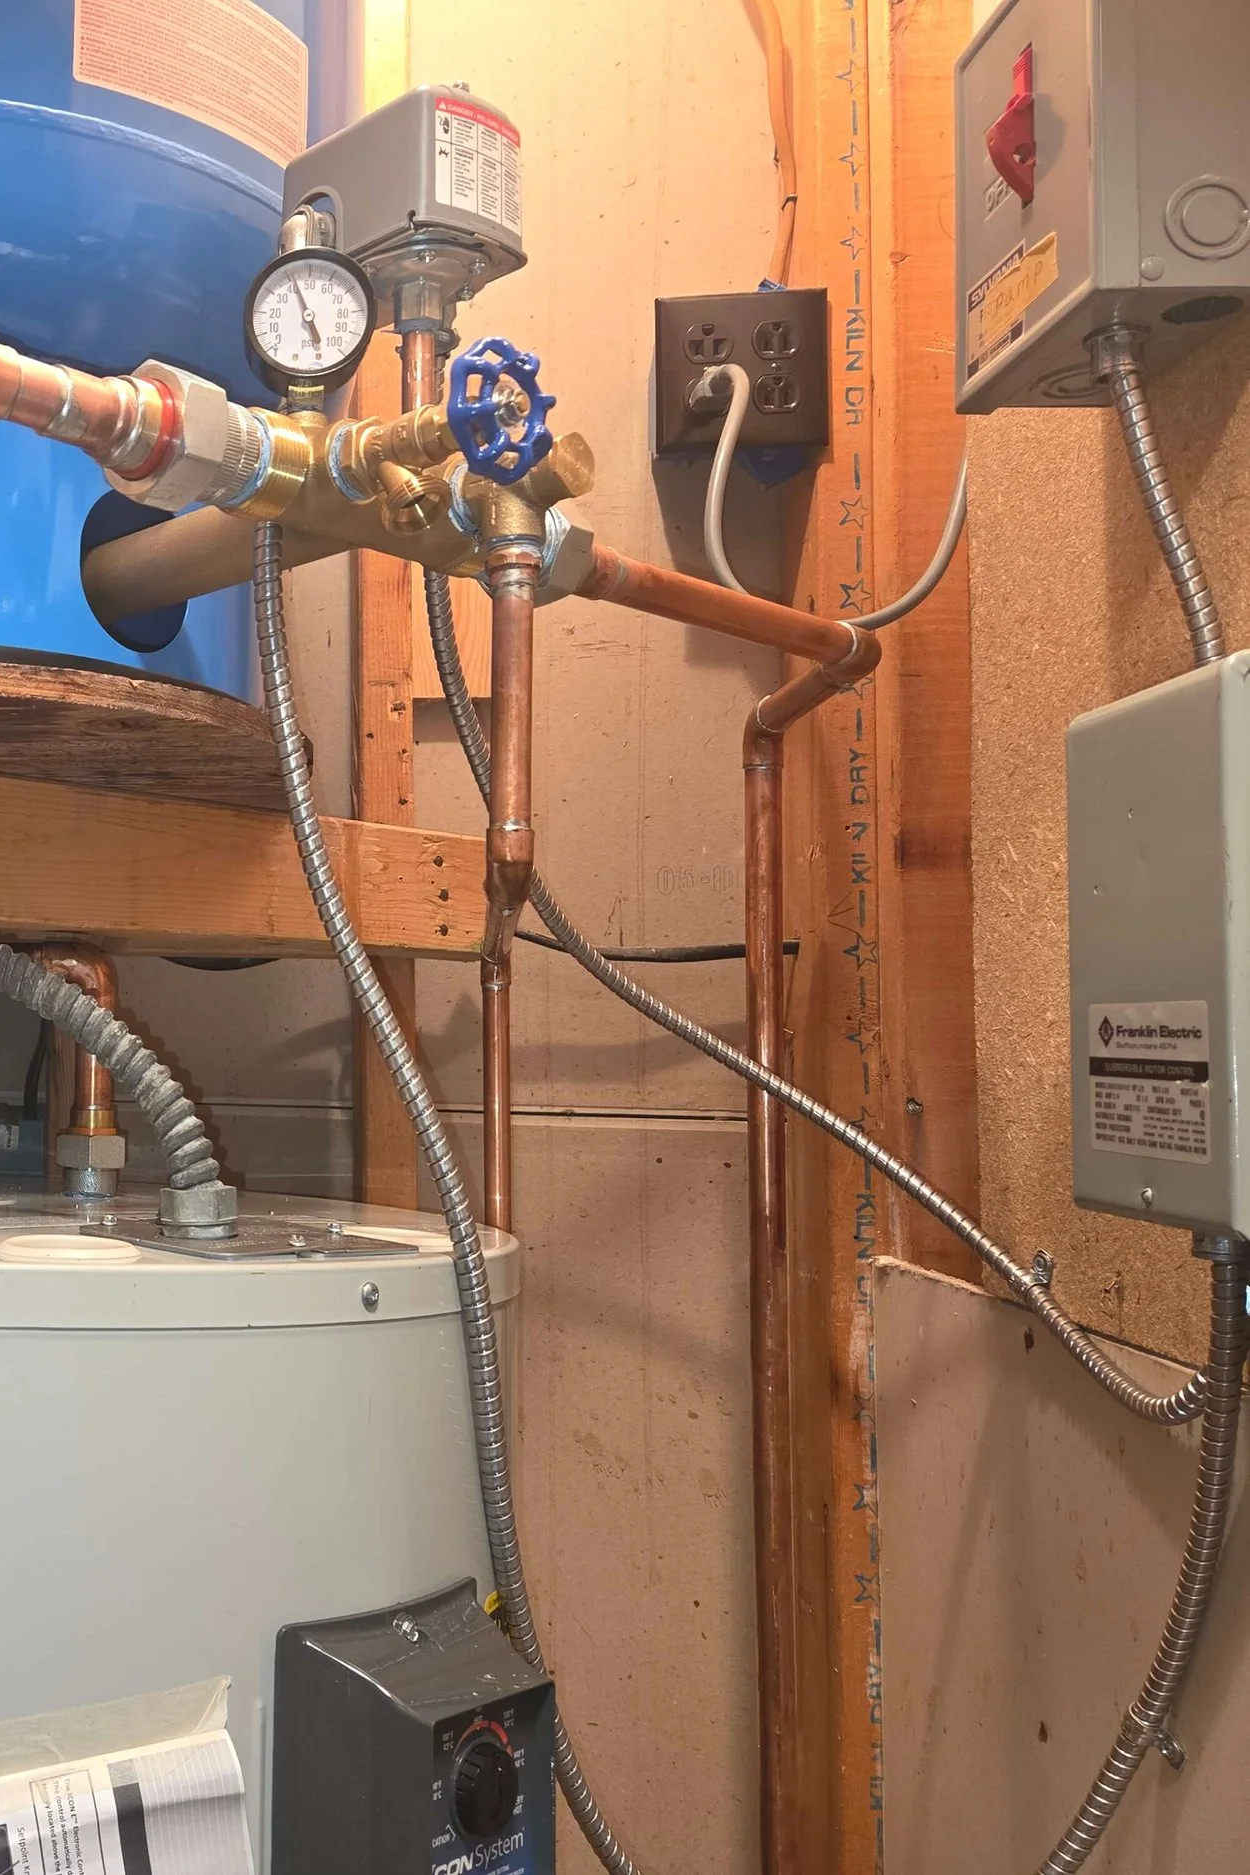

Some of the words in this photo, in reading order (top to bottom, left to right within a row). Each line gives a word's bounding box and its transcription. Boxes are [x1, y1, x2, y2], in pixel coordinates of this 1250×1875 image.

[304, 280, 316, 290] 50
[321, 284, 333, 294] 60
[276, 294, 288, 304] 30
[332, 294, 343, 304] 70
[269, 308, 281, 319] 20
[337, 309, 349, 319] 80
[269, 322, 279, 333] 10
[335, 322, 347, 333] 90
[326, 336, 343, 347] 100
[845, 307, 865, 372] KILN
[1116, 1025, 1158, 1039] Franklin
[1159, 1025, 1203, 1040] Electric
[1167, 1066, 1196, 1077] CONTROL
[55, 1796, 66, 1823] control
[47, 1810, 58, 1838] located
[16, 1827, 29, 1863] Setpoint
[60, 1823, 73, 1869] automatically
[72, 1826, 83, 1858] Electronic
[51, 1839, 61, 1861] above
[475, 1831, 524, 1870] System
[54, 1861, 62, 1873] the
